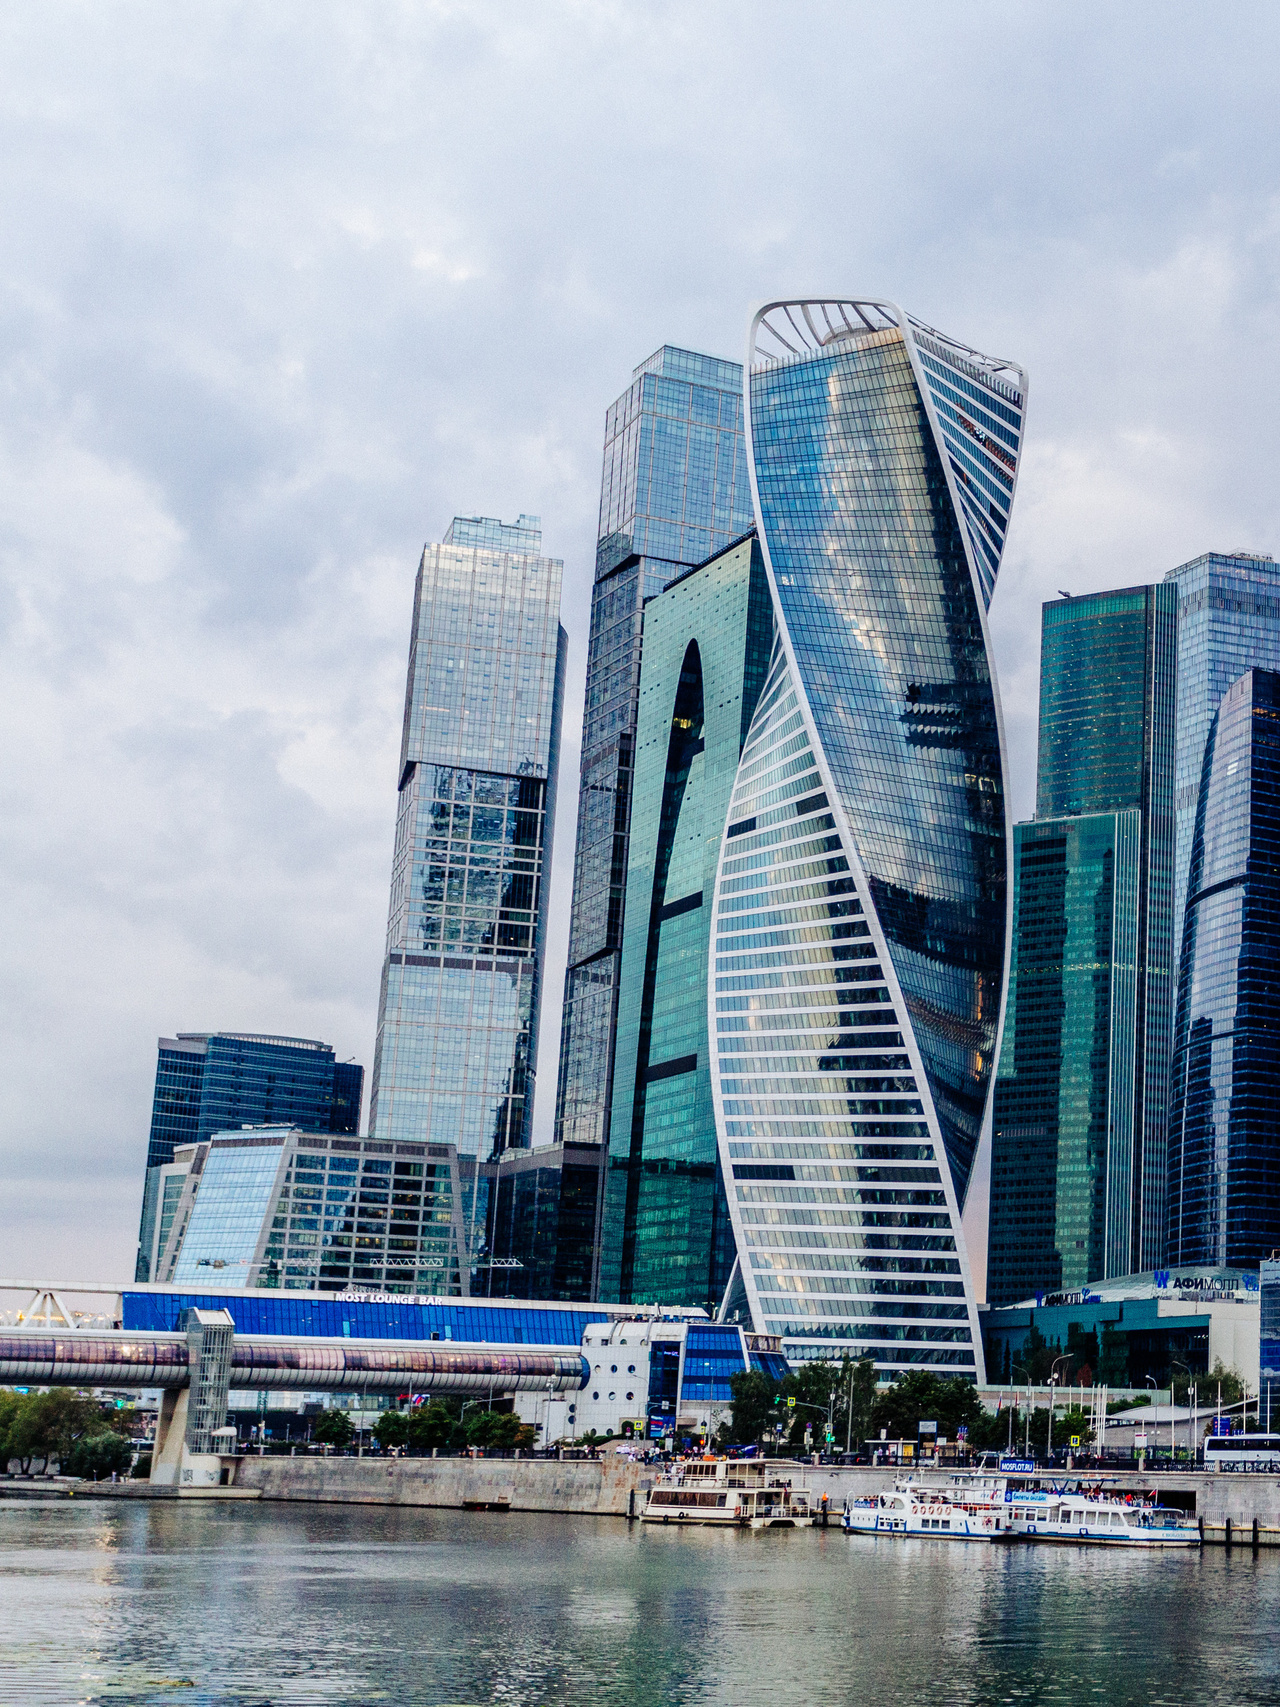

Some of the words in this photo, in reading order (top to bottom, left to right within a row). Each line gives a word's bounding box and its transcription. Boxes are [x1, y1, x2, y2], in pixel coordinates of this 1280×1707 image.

[335, 1292, 367, 1303] MOST
[370, 1294, 415, 1305] LOUNGE
[419, 1297, 443, 1306] BAR
[1001, 1462, 1033, 1472] MOSFLOT.RU
